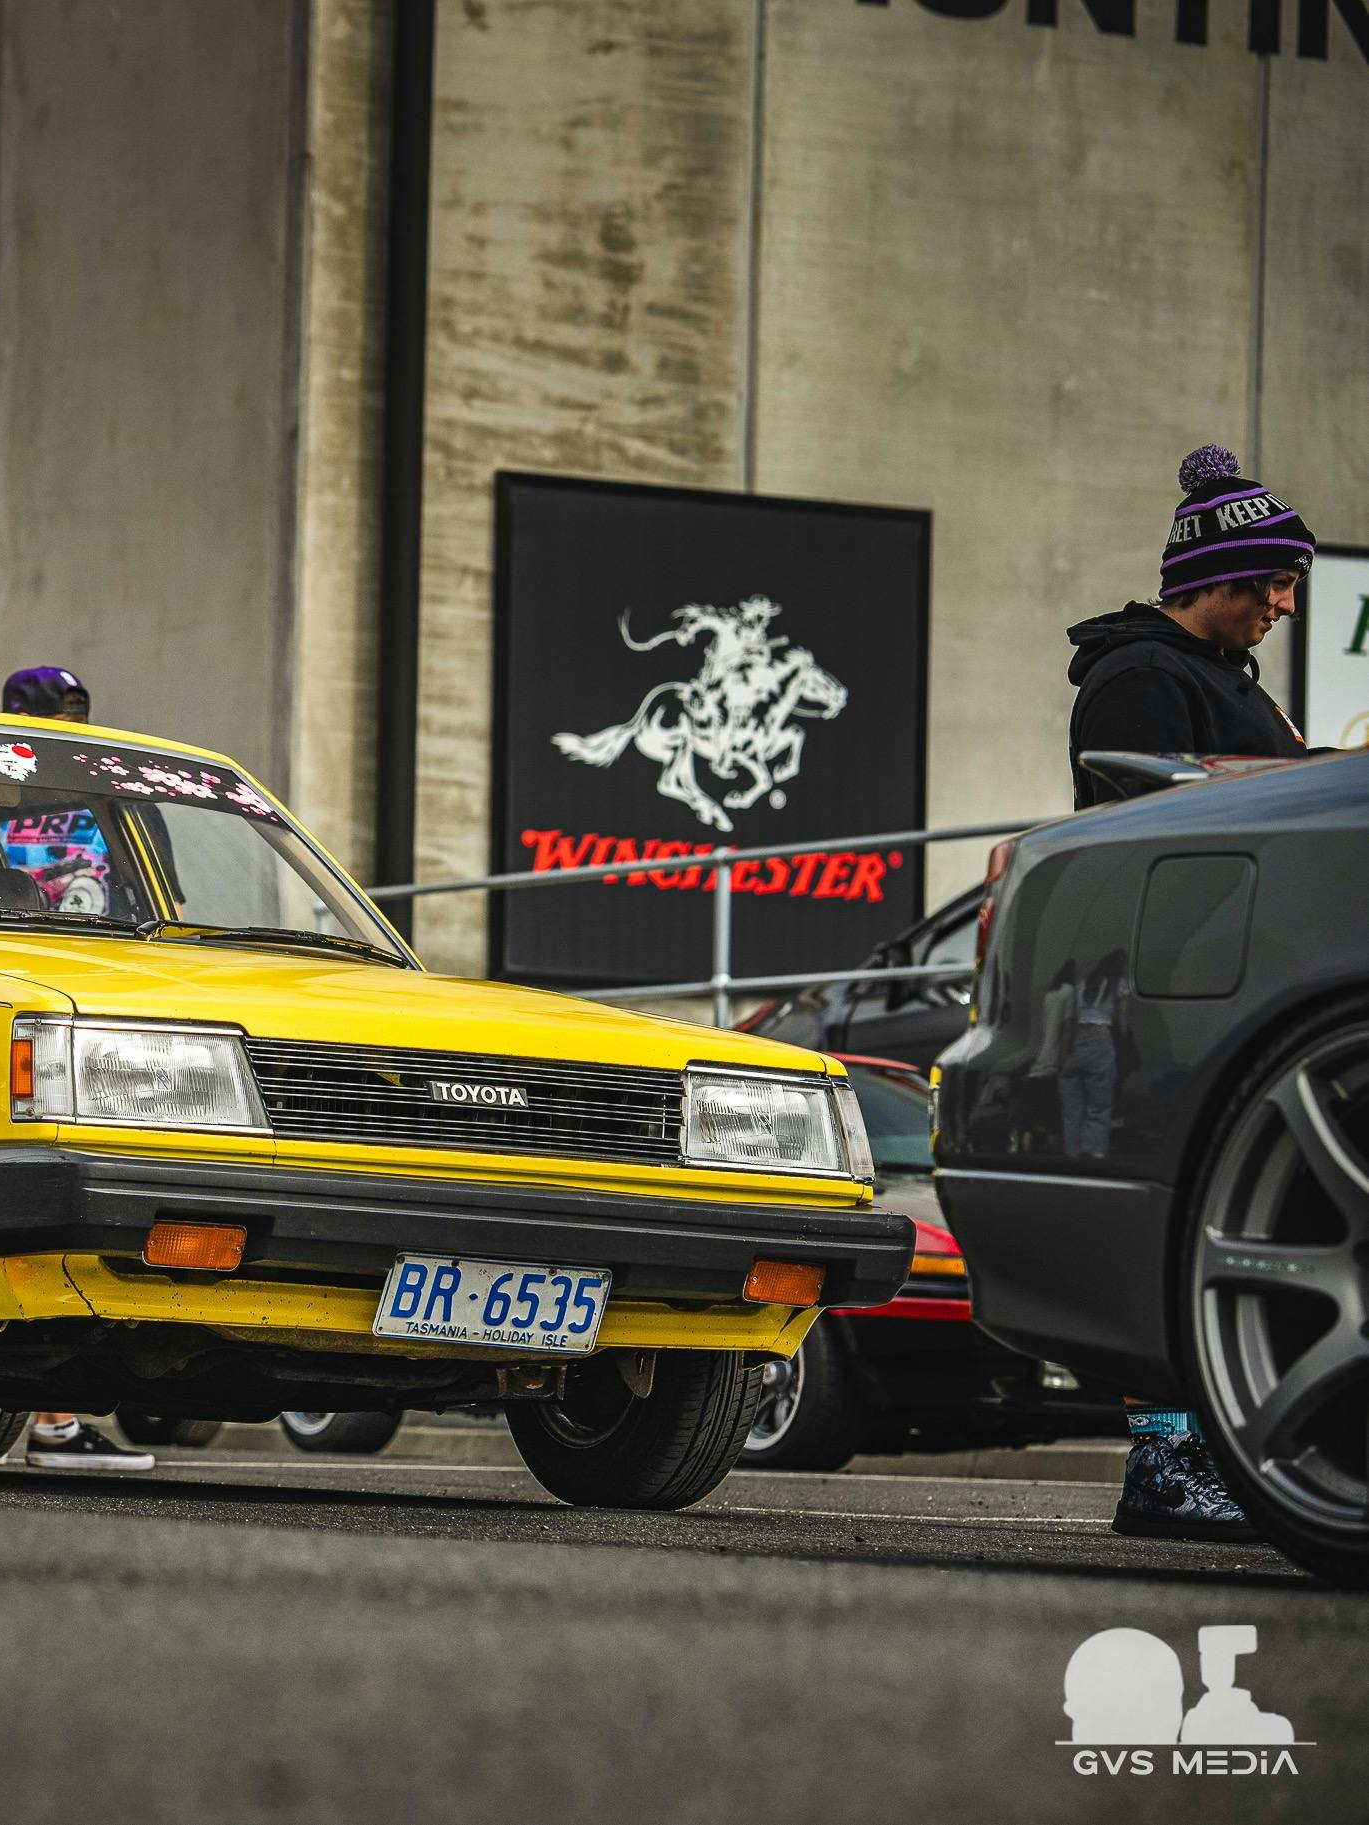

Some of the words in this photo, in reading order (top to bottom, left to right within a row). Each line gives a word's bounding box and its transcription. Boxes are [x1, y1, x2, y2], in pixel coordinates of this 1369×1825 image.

[1168, 514, 1202, 545] REET
[1215, 496, 1271, 533] KEEP
[436, 1082, 526, 1106] TOYOTA
[406, 1321, 467, 1339] TASMANIA
[483, 1328, 535, 1344] HOLIDAY
[542, 1333, 569, 1347] ISLE
